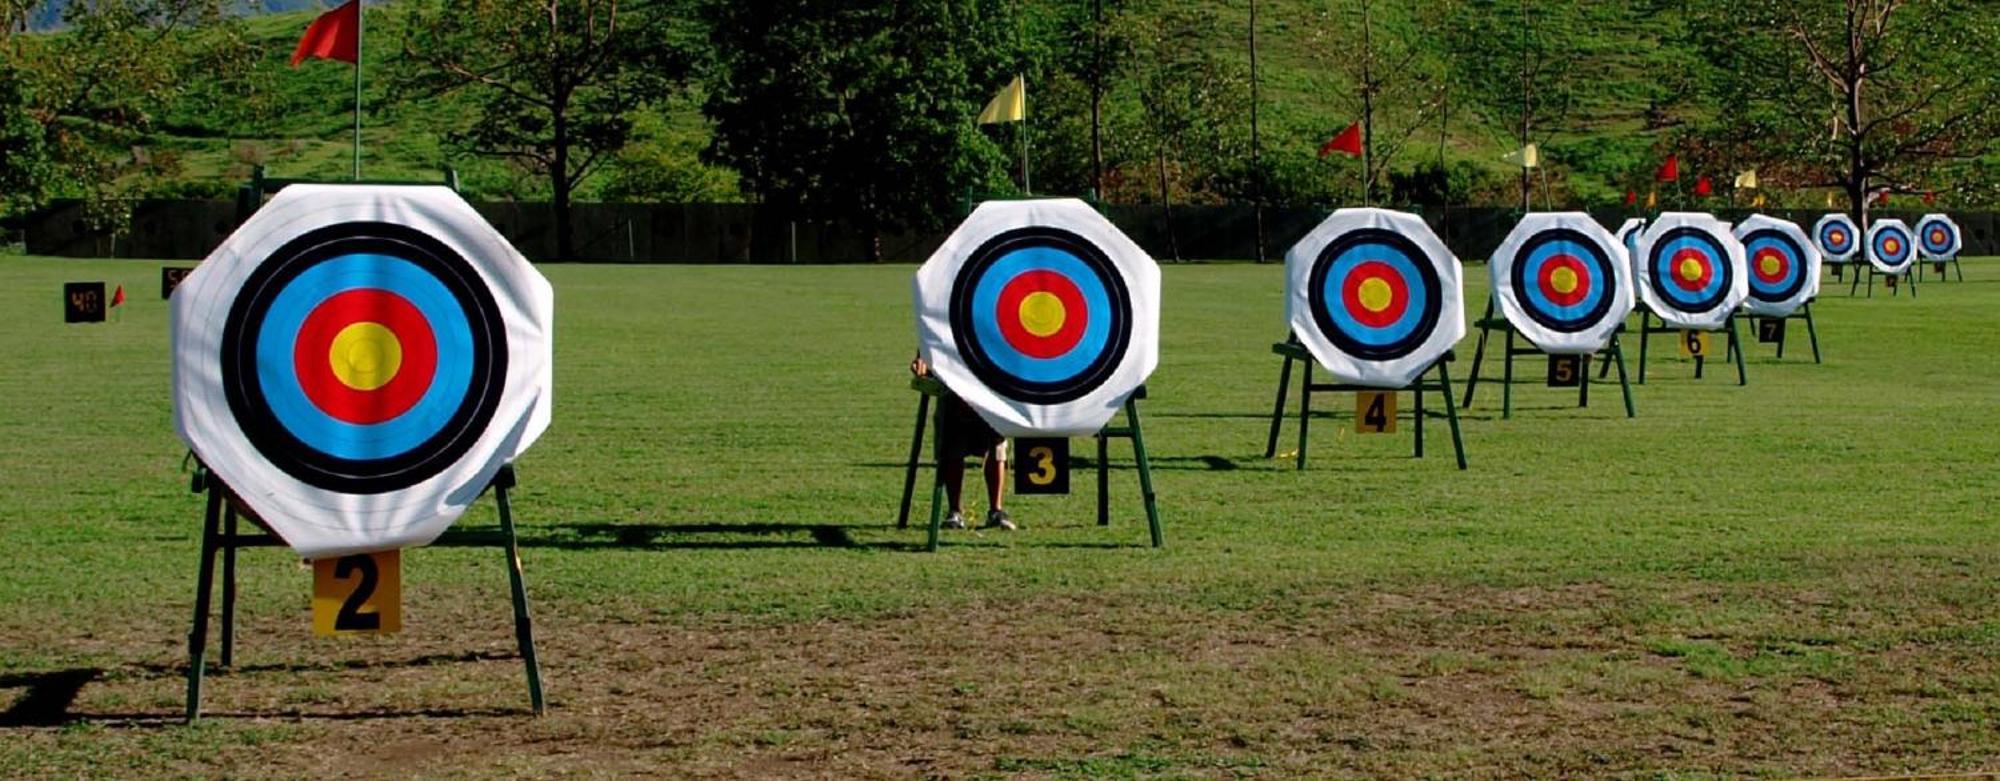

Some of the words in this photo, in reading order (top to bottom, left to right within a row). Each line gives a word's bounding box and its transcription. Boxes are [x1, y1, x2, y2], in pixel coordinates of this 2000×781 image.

[1687, 330, 1701, 354] 6
[1764, 323, 1778, 340] 7
[1556, 360, 1571, 381] 5
[1365, 393, 1386, 432] 4
[1029, 447, 1056, 484] 3
[334, 554, 380, 630] 2
